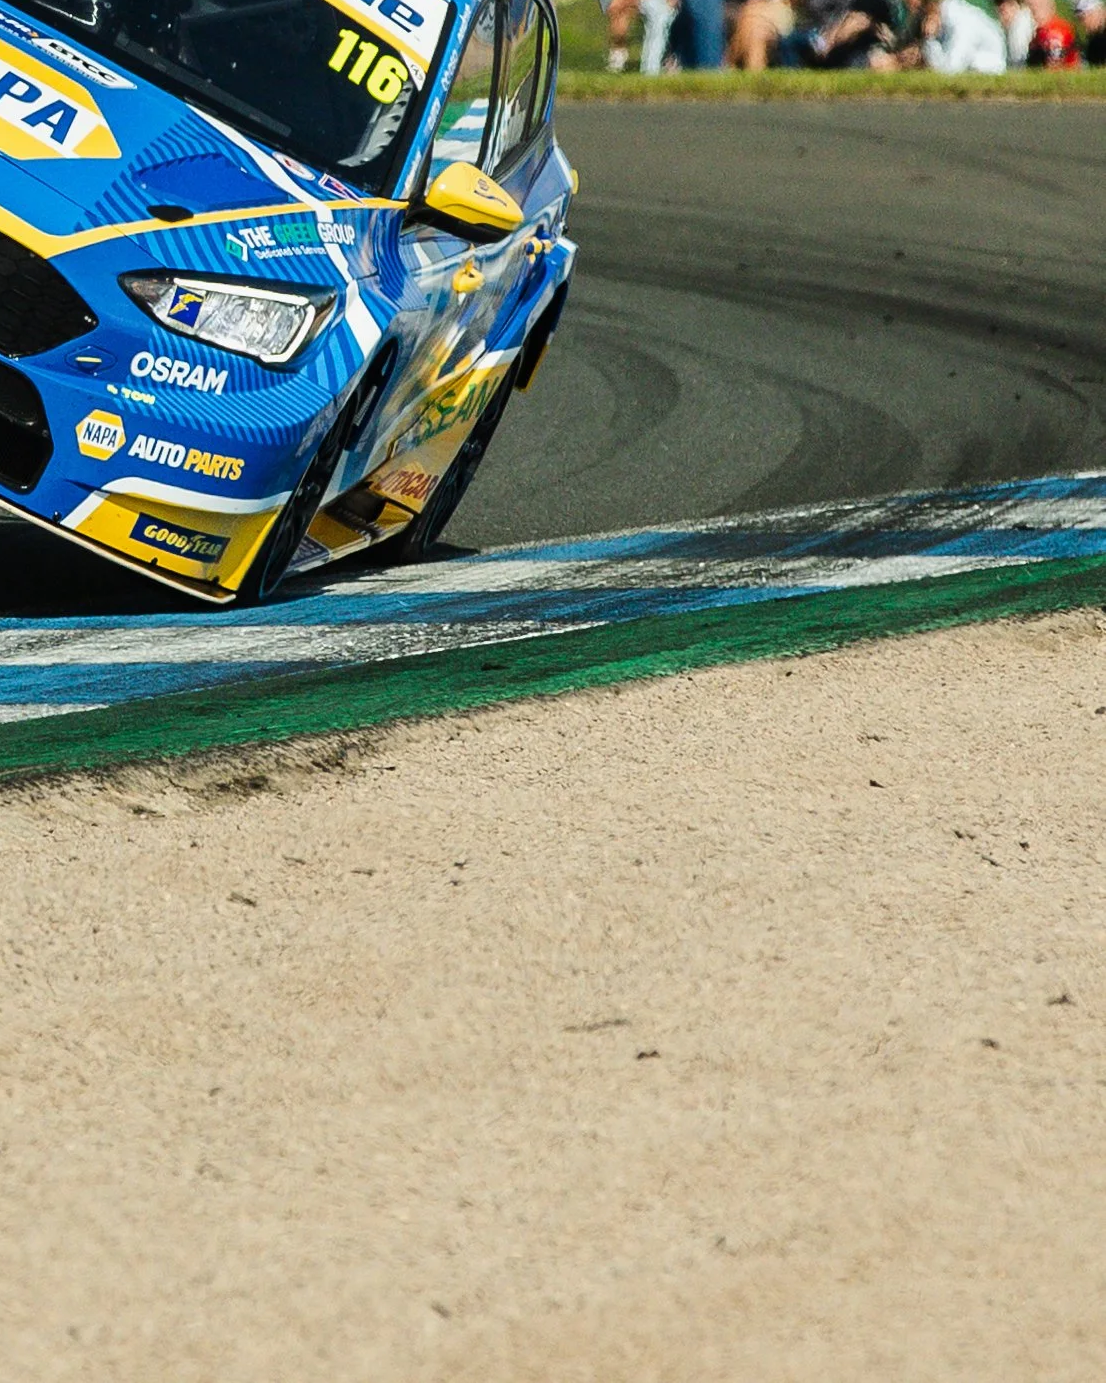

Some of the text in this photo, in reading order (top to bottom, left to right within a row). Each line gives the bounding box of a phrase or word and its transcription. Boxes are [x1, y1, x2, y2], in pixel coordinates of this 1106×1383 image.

[328, 28, 409, 105] 116
[238, 221, 356, 249] THE GREEN GROUP
[130, 351, 229, 396] OSRAM
[121, 387, 156, 405] TOW
[82, 422, 245, 481] NAPA AUTO PARTS
[143, 524, 223, 555] GOODYEAR
